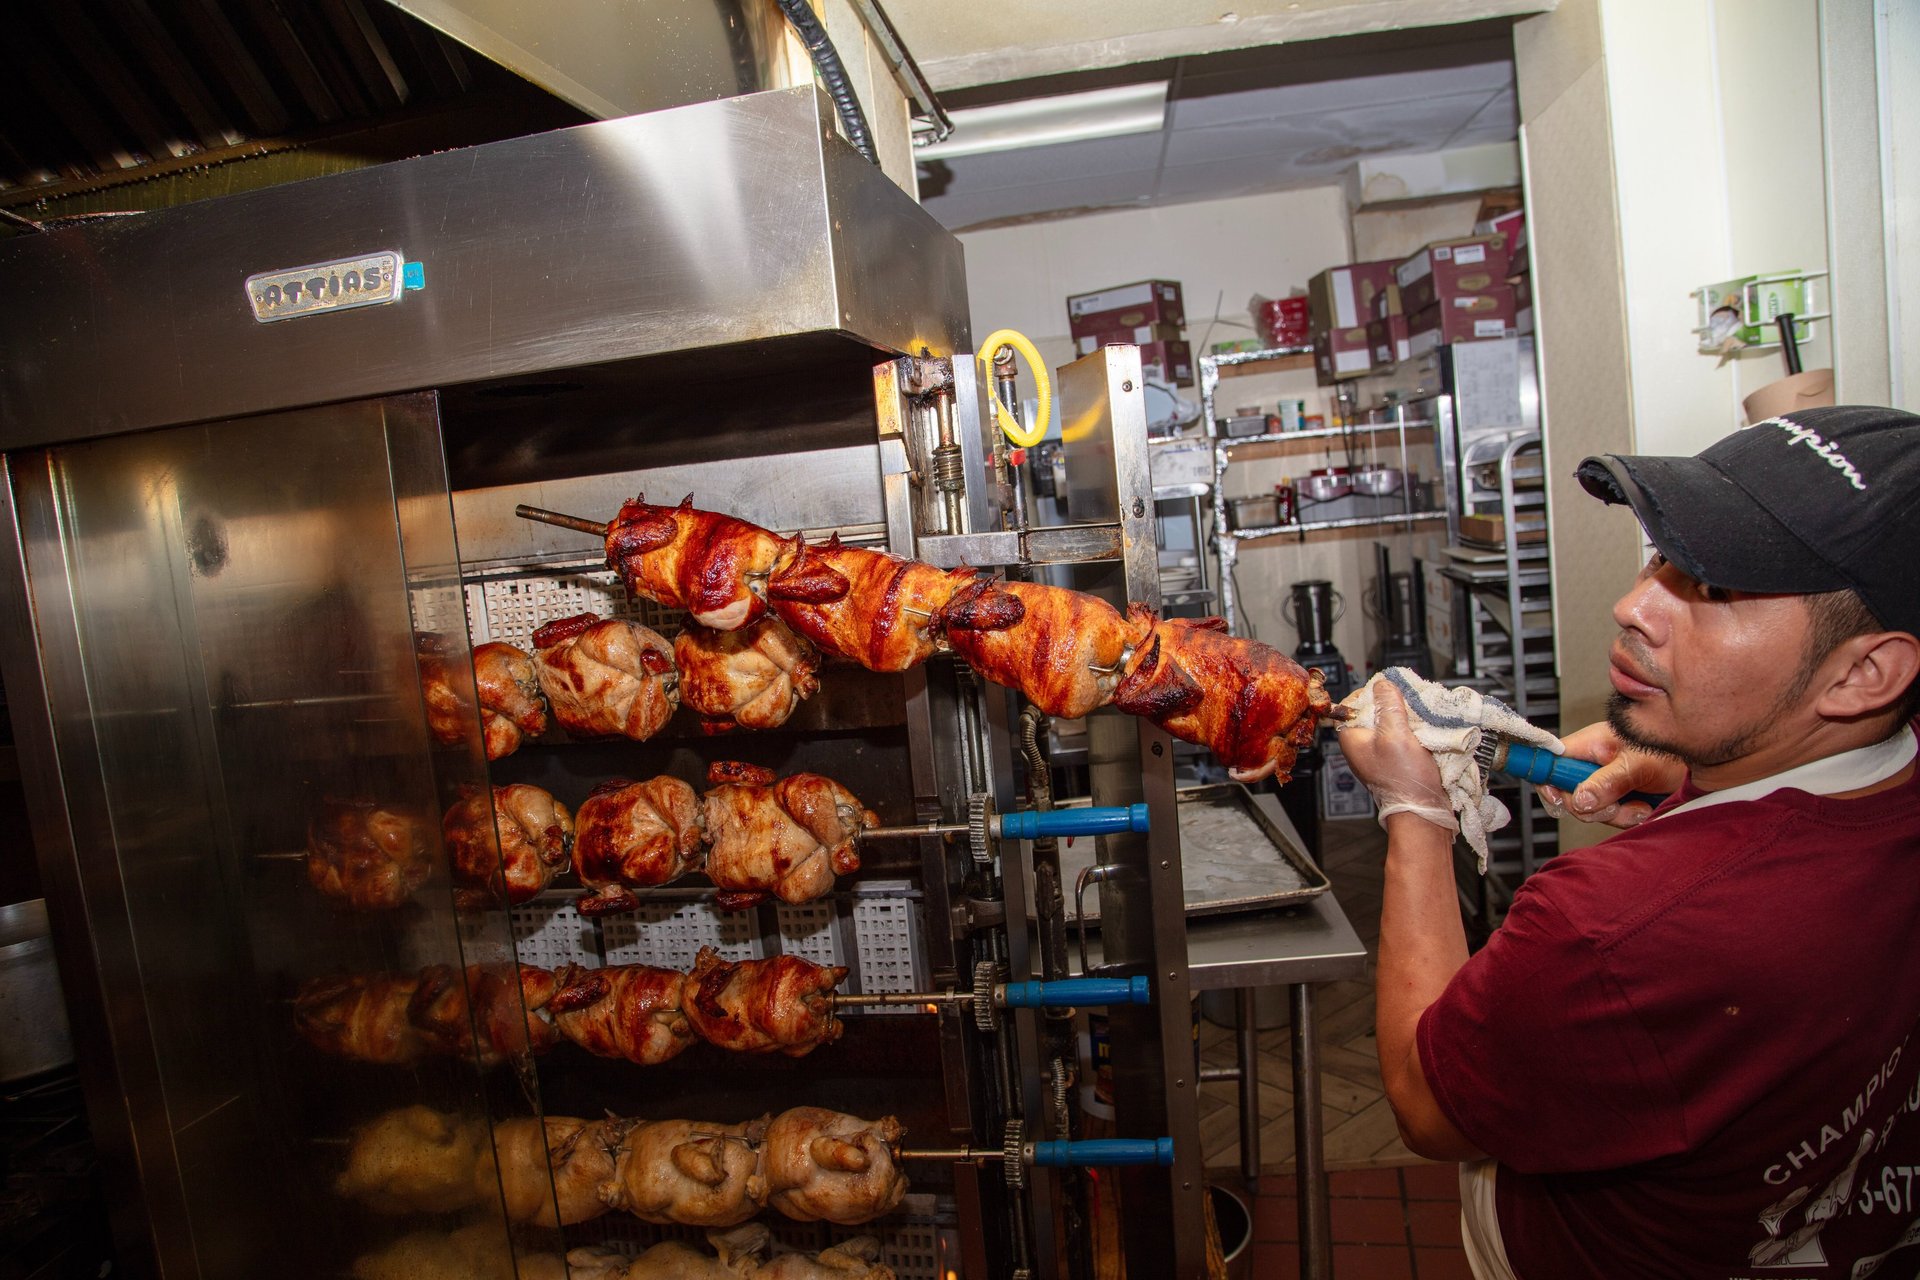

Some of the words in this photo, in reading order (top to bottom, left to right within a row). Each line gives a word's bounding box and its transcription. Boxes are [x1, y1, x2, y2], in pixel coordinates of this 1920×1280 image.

[1765, 416, 1867, 490] mpion
[1763, 1035, 1909, 1185] CHAMPIO
[1847, 1166, 1920, 1216] 3-67
